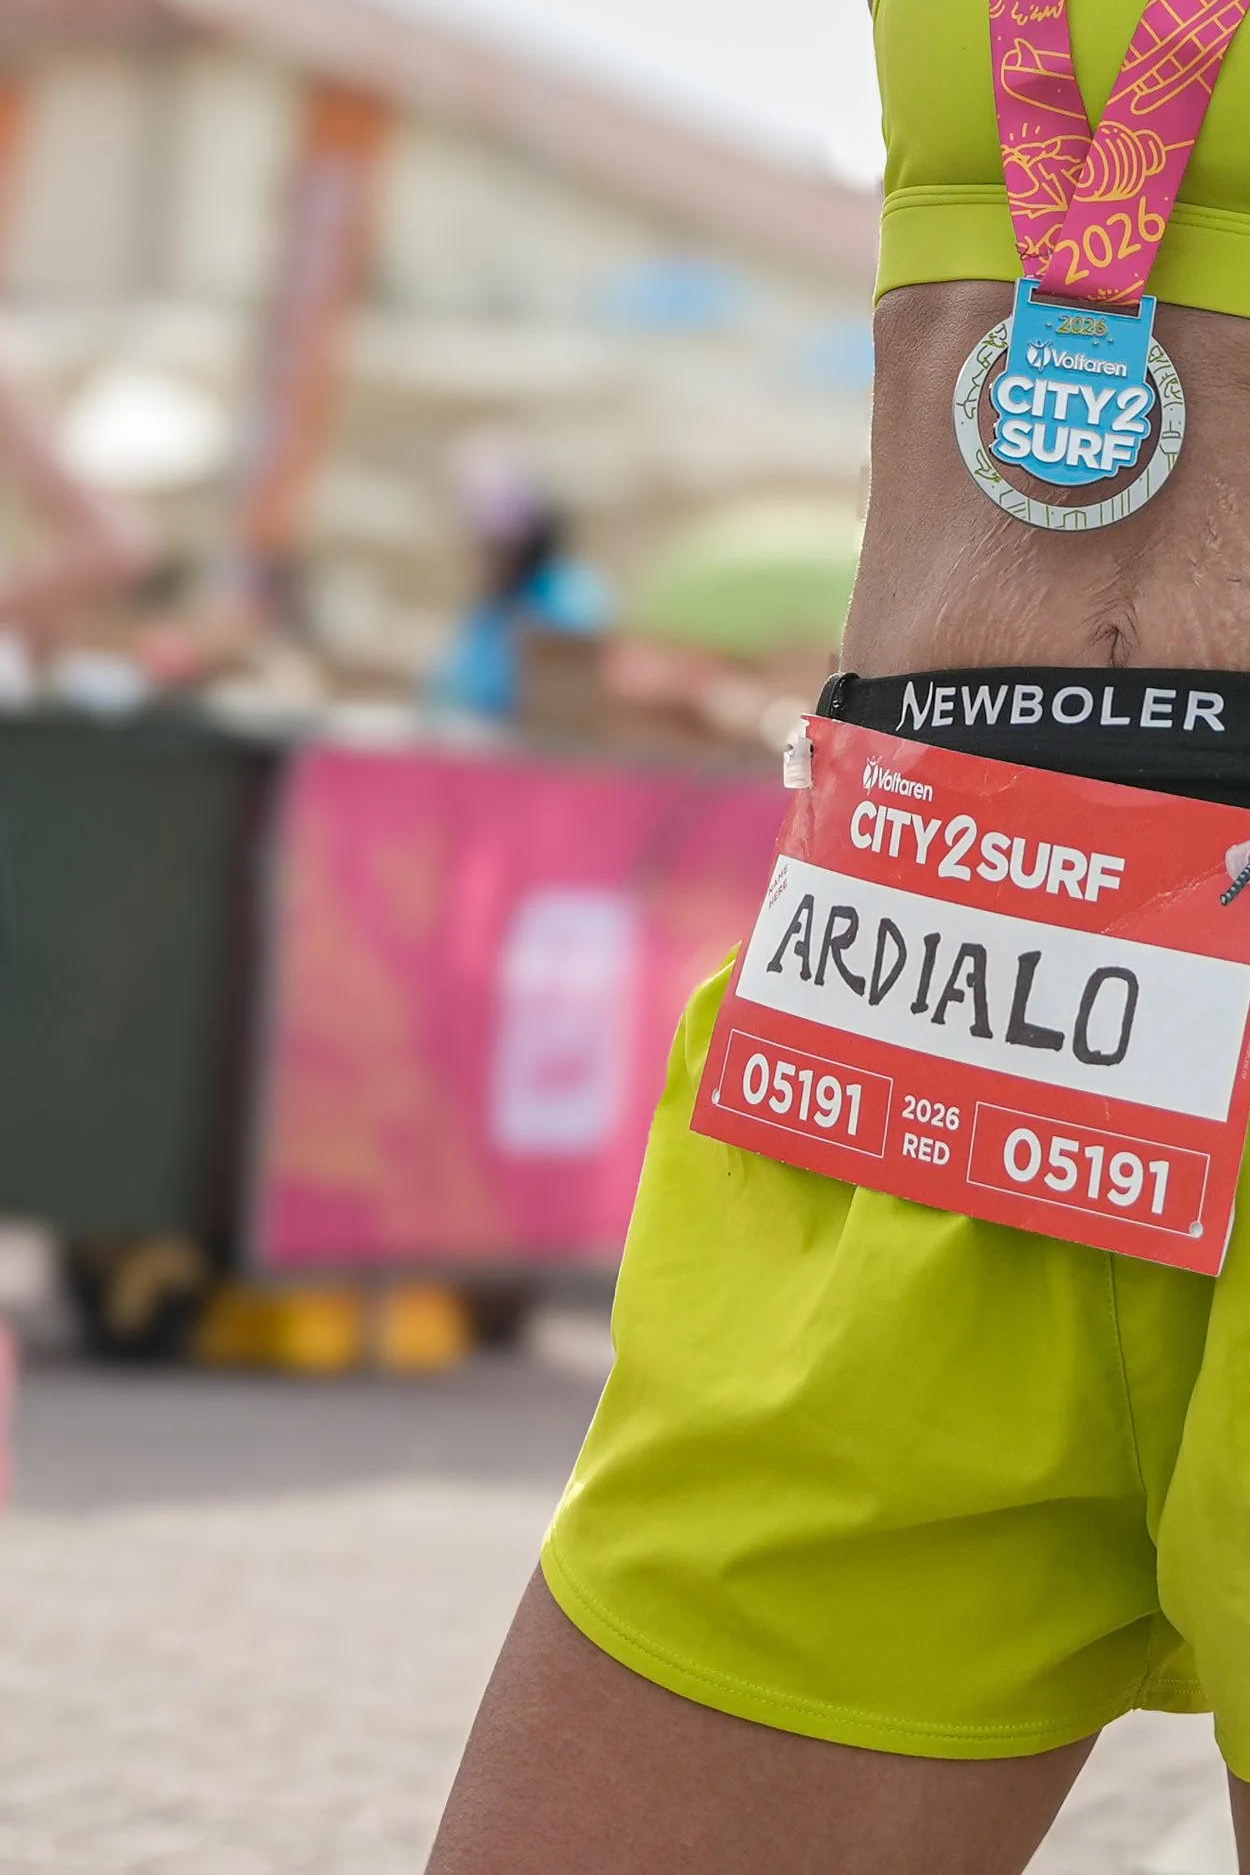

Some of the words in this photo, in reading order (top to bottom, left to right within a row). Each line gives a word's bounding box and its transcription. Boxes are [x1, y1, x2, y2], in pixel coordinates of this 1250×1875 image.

[1054, 196, 1166, 285] 2026
[1056, 315, 1108, 336] 2026
[1051, 348, 1128, 377] Voltaren
[998, 376, 1150, 433] CITY2
[1000, 420, 1135, 471] SURF
[895, 680, 1225, 732] NEWBOLER
[878, 766, 934, 803] Voltaren
[850, 800, 1126, 903] CITY2SURF
[766, 893, 1140, 1067] ARDIALO
[742, 1053, 862, 1137] 05191
[901, 1095, 961, 1131] 2026
[902, 1132, 951, 1166] RED
[1003, 1128, 1170, 1215] 05191
